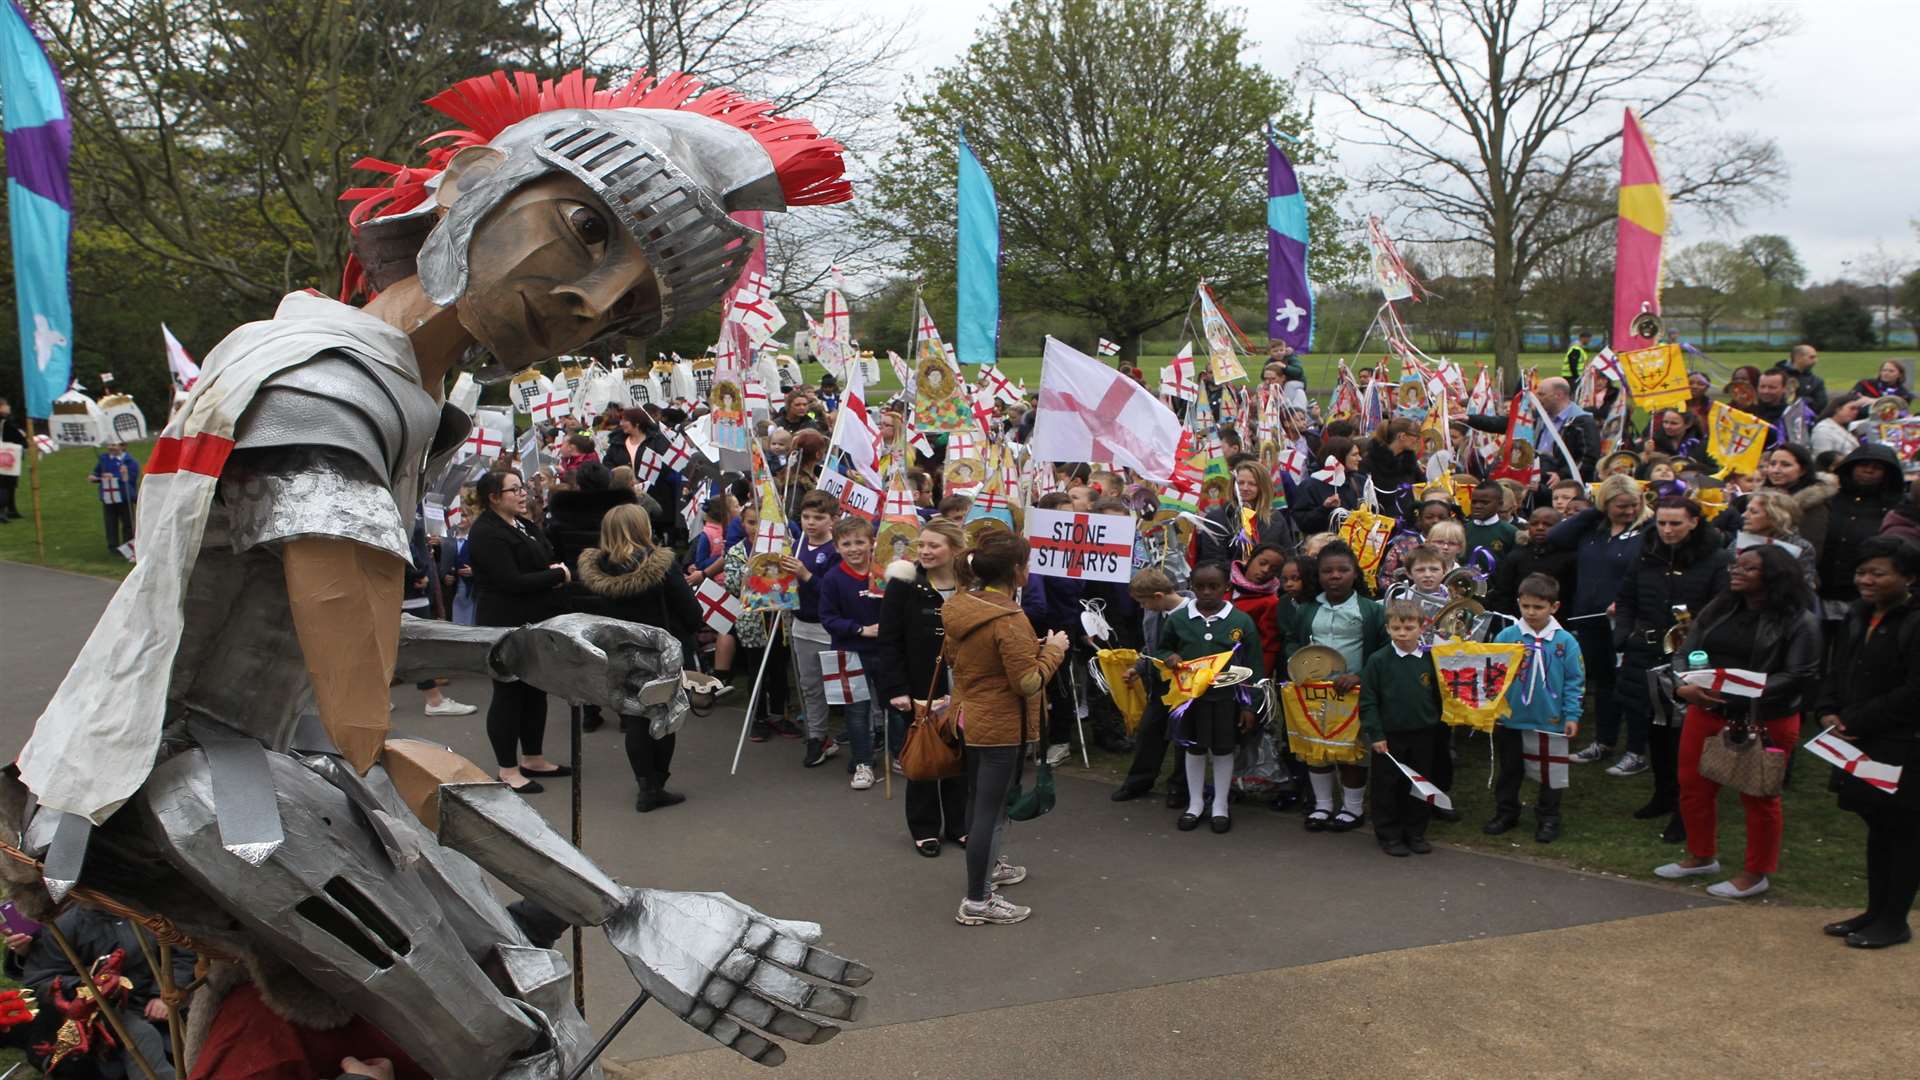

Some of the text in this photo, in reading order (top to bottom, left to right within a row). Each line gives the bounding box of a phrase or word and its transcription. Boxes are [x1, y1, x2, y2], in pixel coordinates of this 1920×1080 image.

[1052, 521, 1106, 546] STONE
[1037, 545, 1058, 567] ST
[1061, 548, 1118, 573] MARYS
